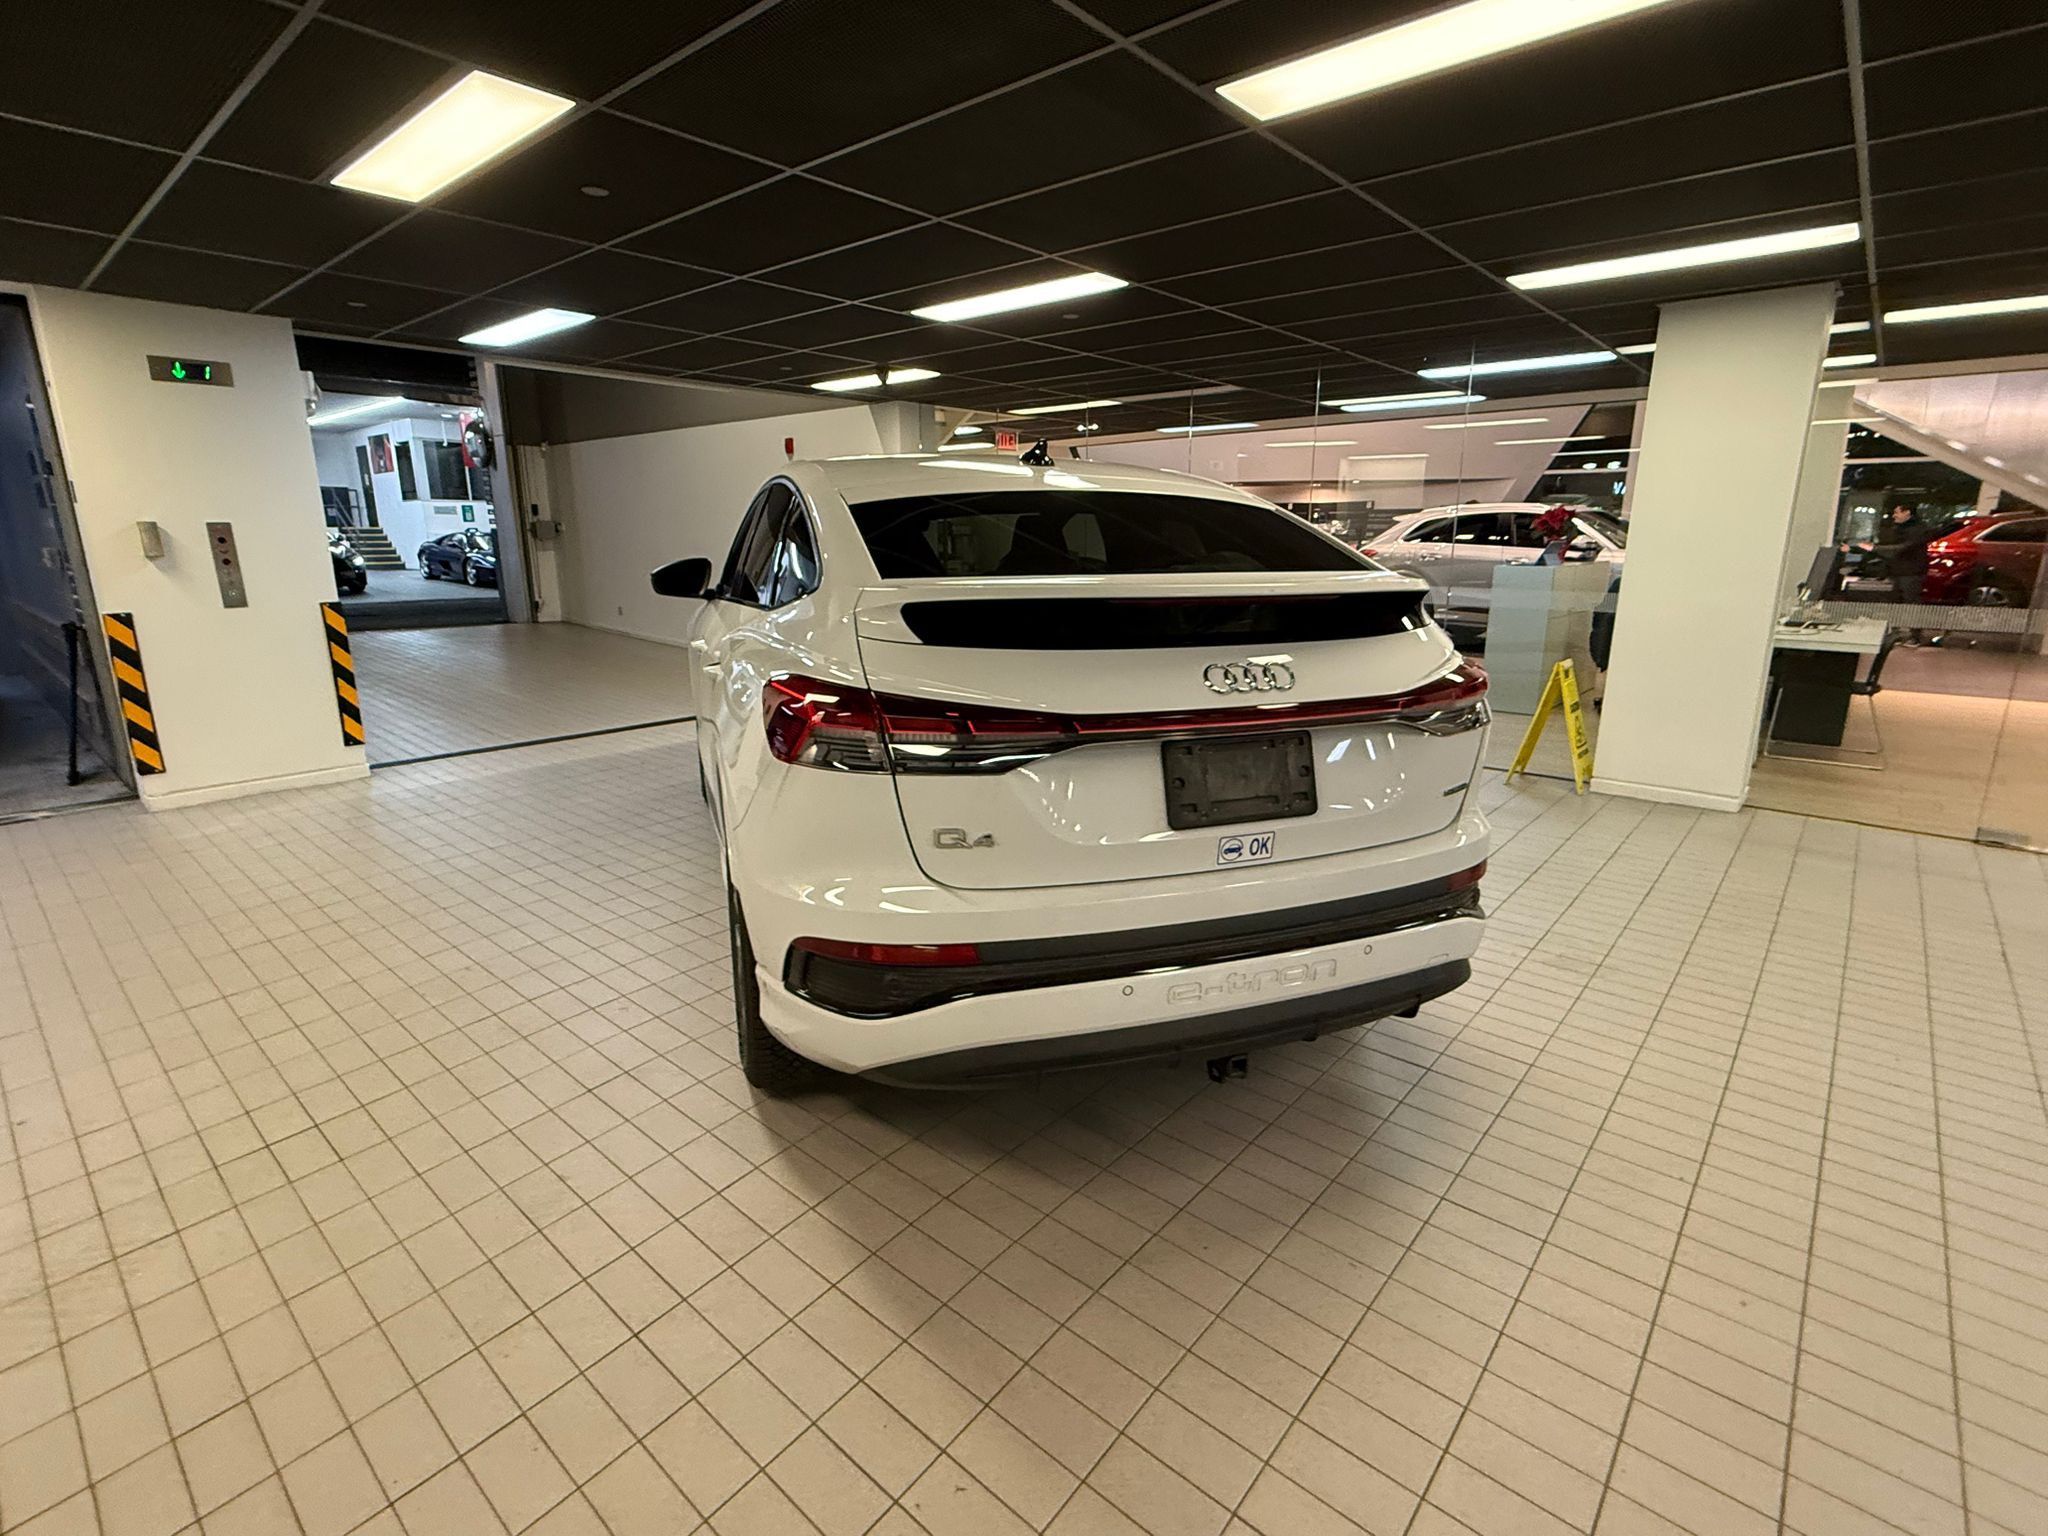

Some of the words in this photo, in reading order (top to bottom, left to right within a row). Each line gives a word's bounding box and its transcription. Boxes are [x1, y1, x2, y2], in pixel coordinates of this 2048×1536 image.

[204, 365, 211, 380] 1
[933, 827, 995, 849] Q4
[1249, 836, 1271, 856] OK
[1167, 958, 1337, 1005] e-tron
